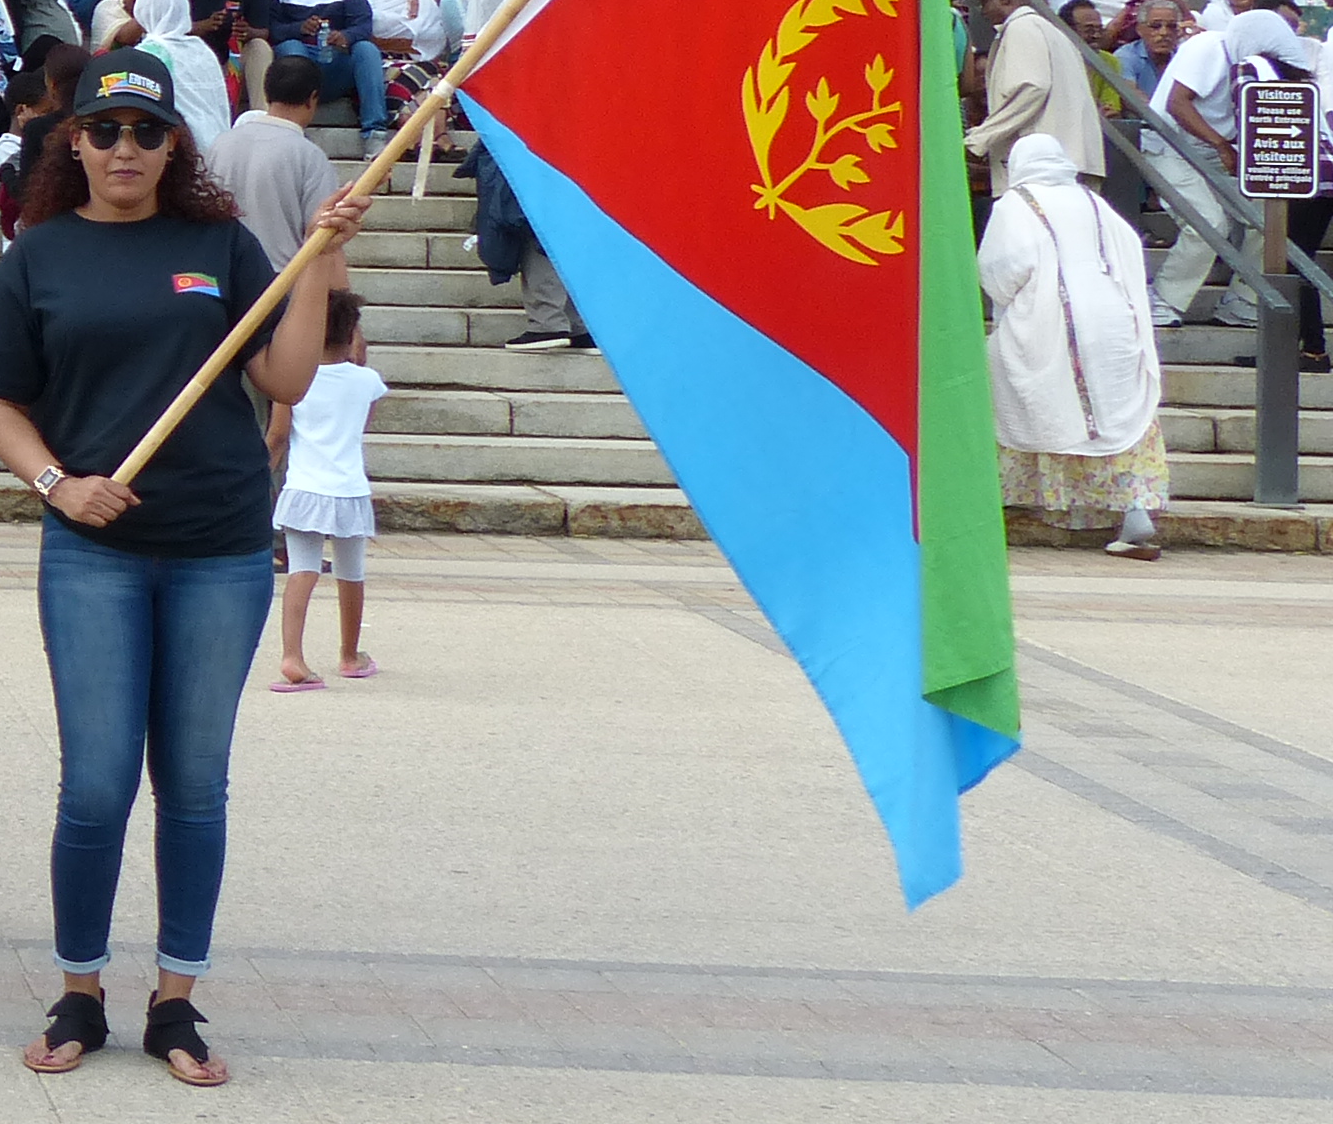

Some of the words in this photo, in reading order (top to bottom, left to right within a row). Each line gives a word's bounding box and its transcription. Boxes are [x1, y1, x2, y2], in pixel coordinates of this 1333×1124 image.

[1256, 89, 1303, 100] Visitors
[1253, 138, 1279, 149] Avis
[1282, 140, 1306, 149] aux
[1253, 151, 1306, 162] visiteurs
